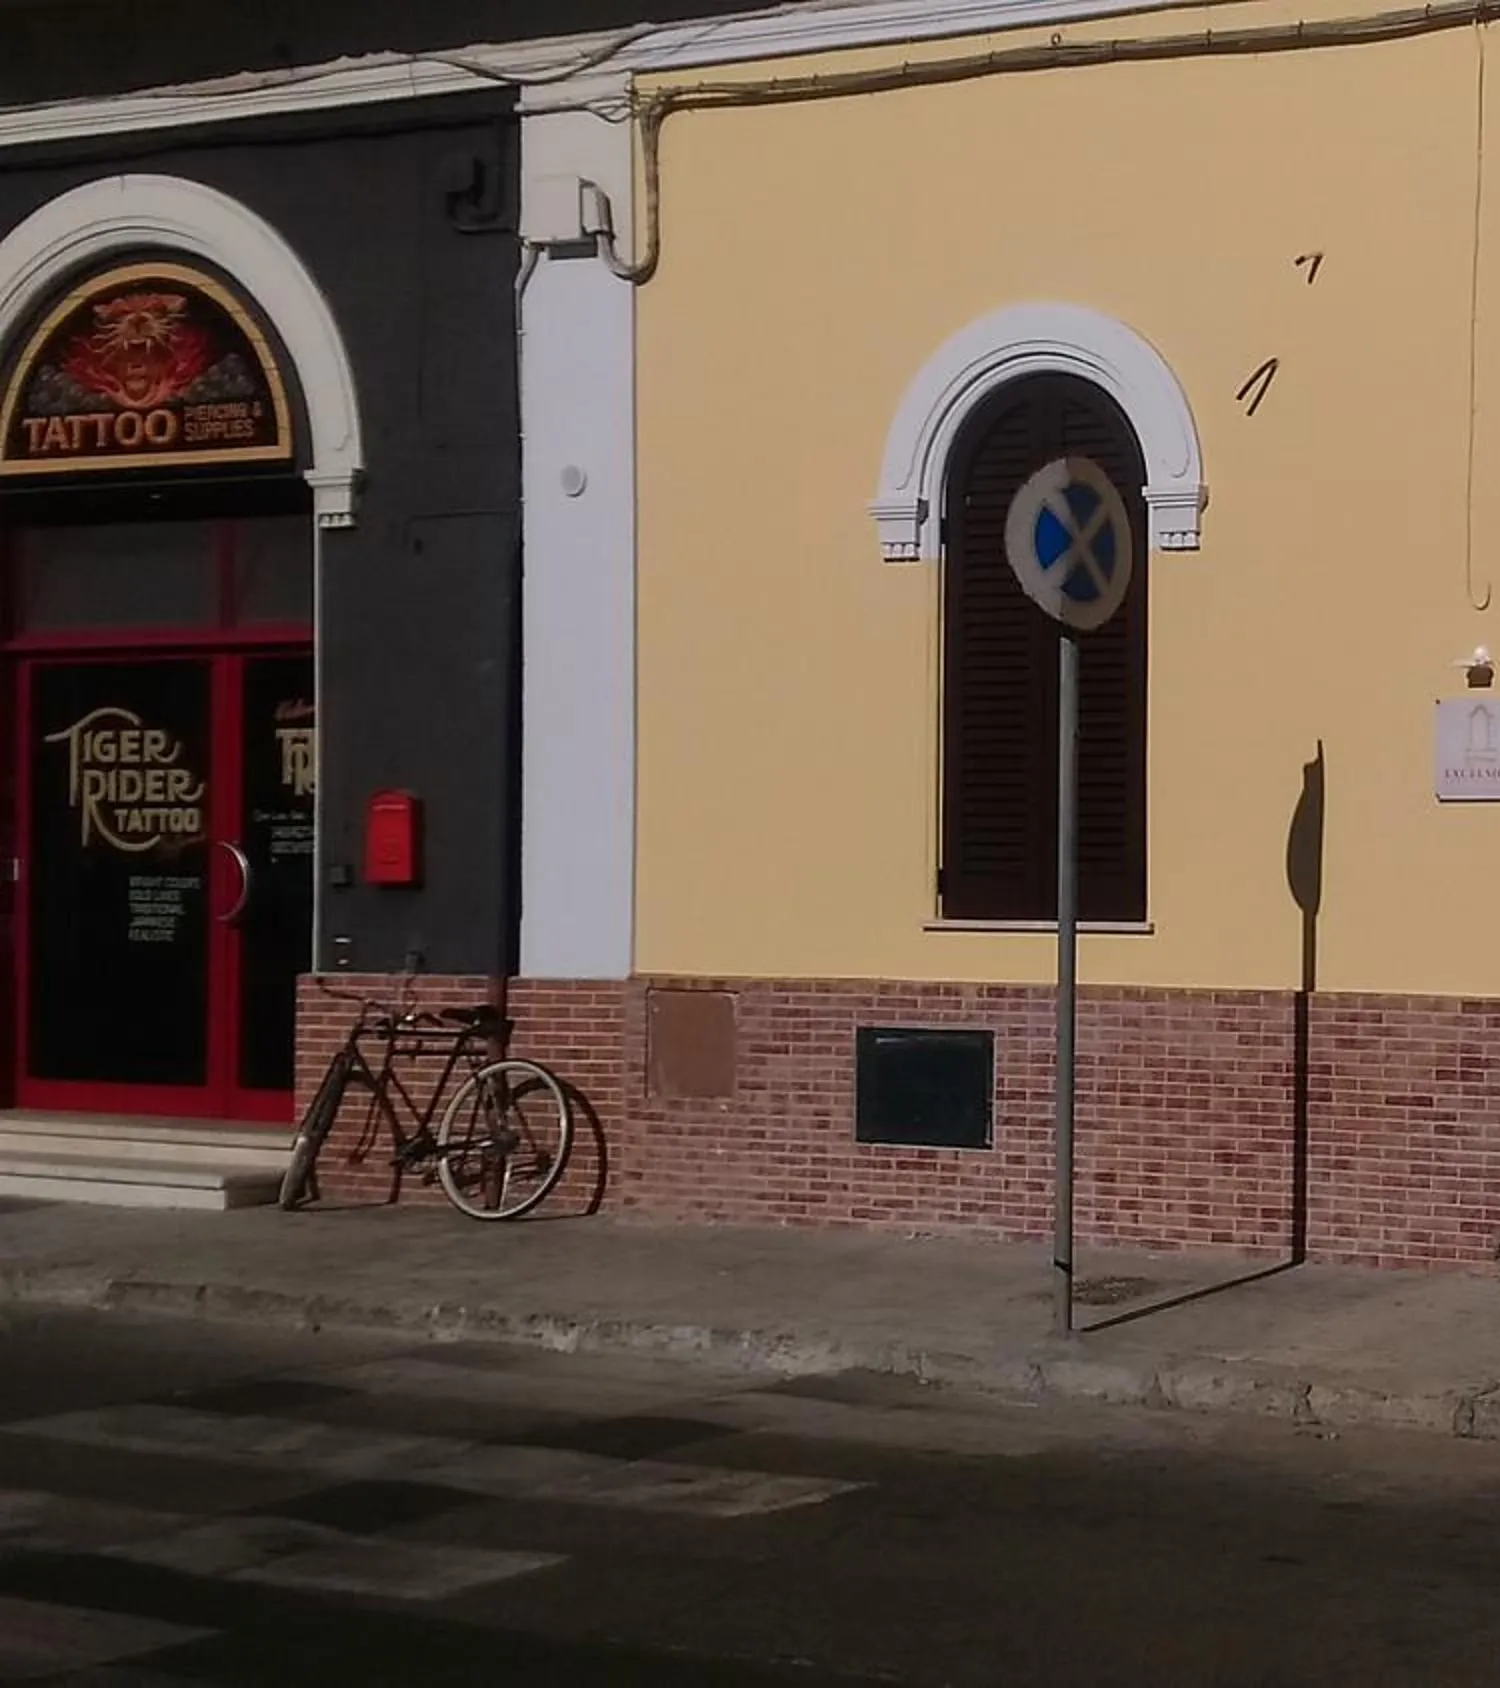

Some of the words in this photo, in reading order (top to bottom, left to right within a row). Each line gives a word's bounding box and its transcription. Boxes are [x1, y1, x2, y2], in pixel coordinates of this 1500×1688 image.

[22, 409, 177, 452] TATTOO
[184, 417, 256, 442] SUPPLIES
[44, 706, 182, 807] TIGER
[81, 767, 206, 852] RIDER
[112, 806, 201, 833] TATTOO
